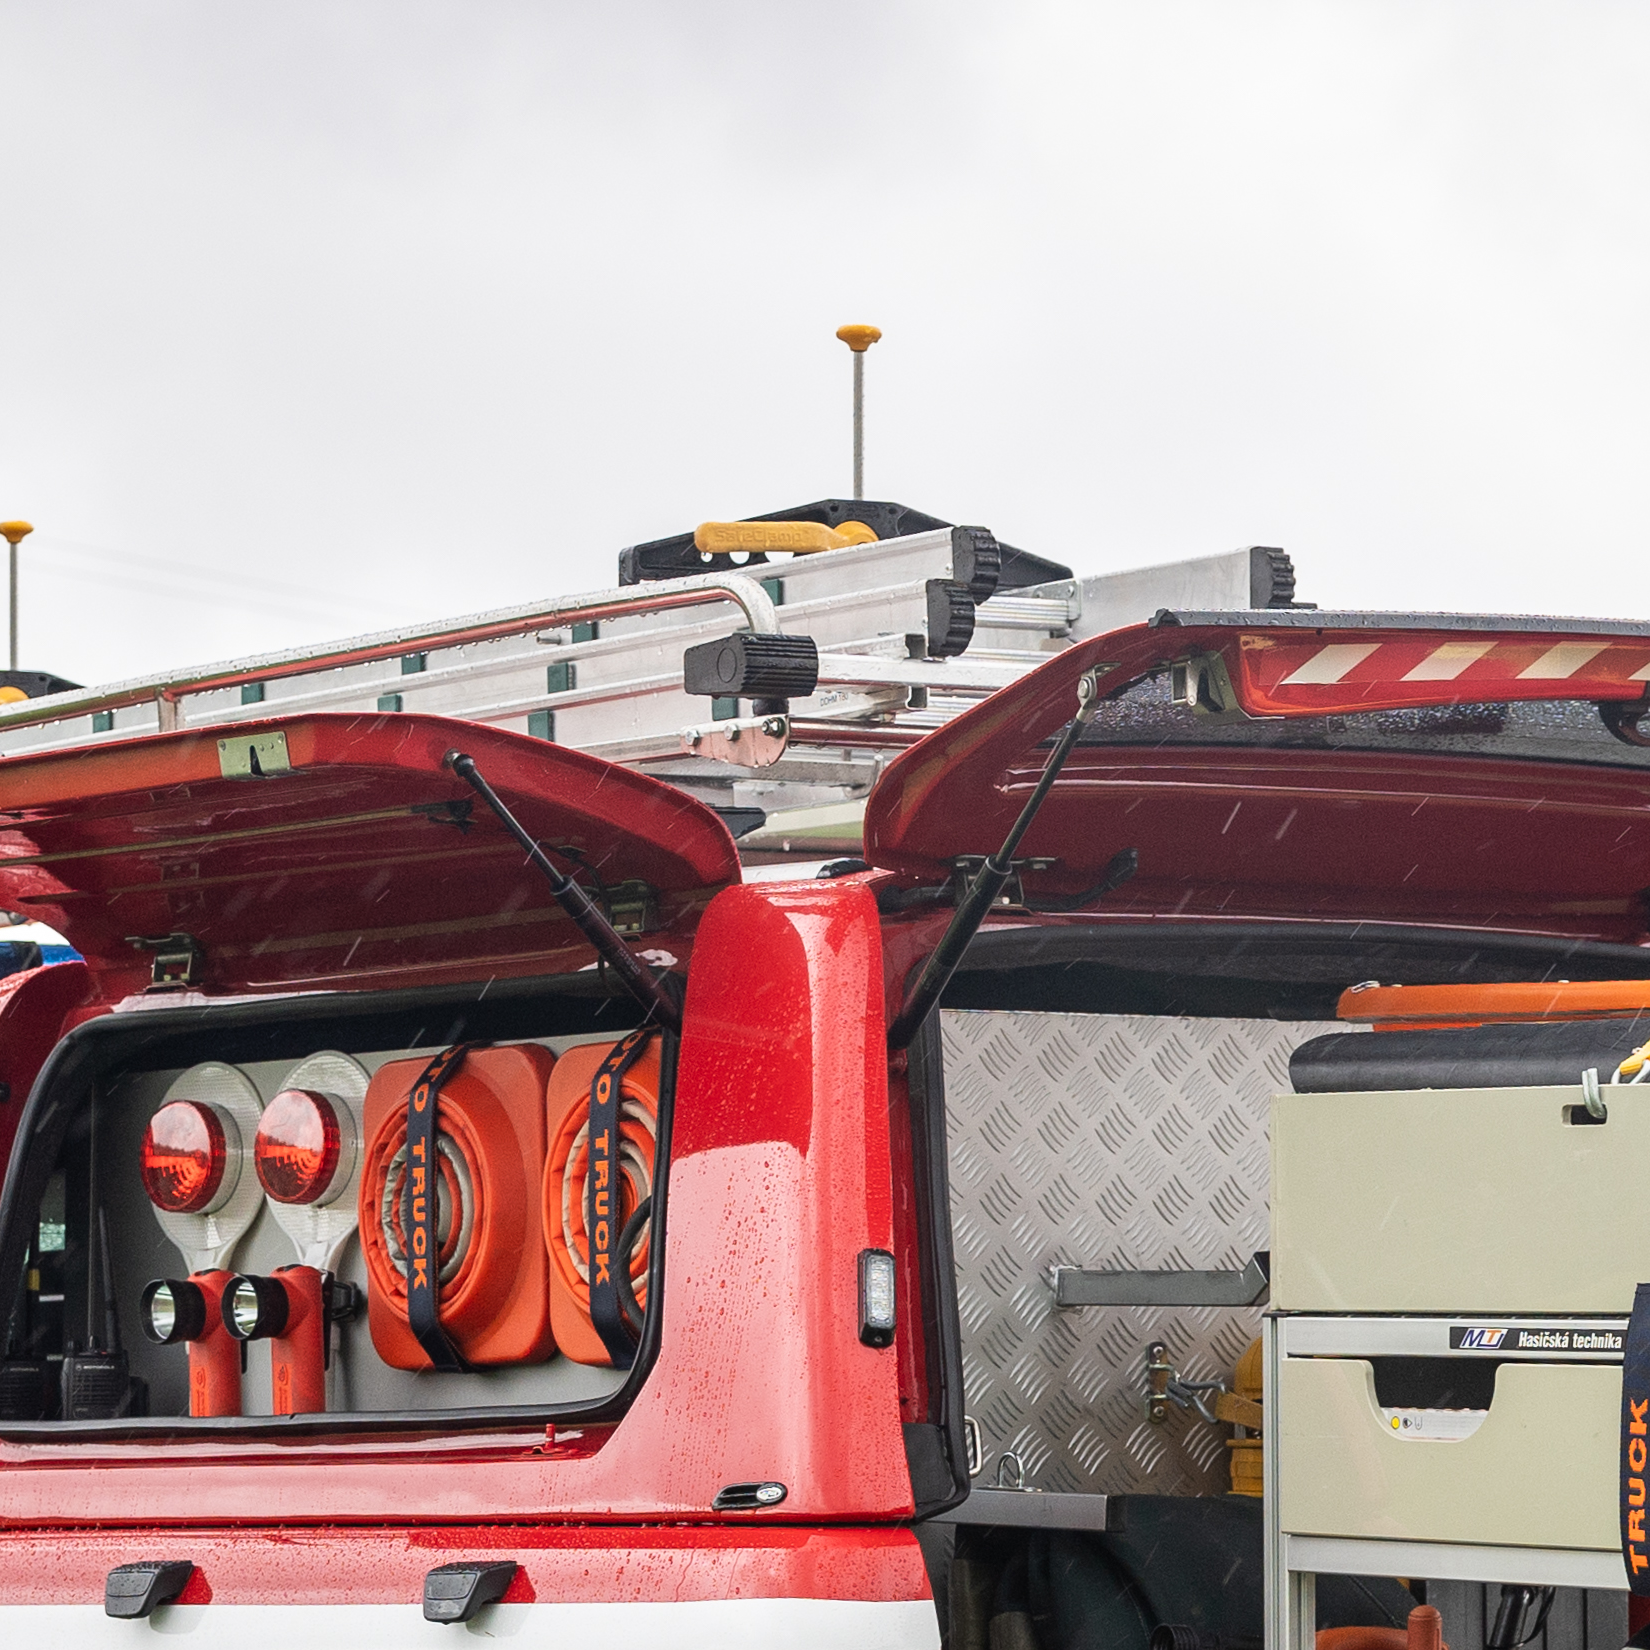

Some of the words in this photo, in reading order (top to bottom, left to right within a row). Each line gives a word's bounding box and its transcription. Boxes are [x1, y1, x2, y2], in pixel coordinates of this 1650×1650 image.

[412, 1136, 428, 1289] TRUCK
[594, 1128, 610, 1287] TRUCK
[1518, 1331, 1569, 1349] Hasičská
[1572, 1332, 1622, 1349] technika
[1628, 1397, 1649, 1575] TRUCK
